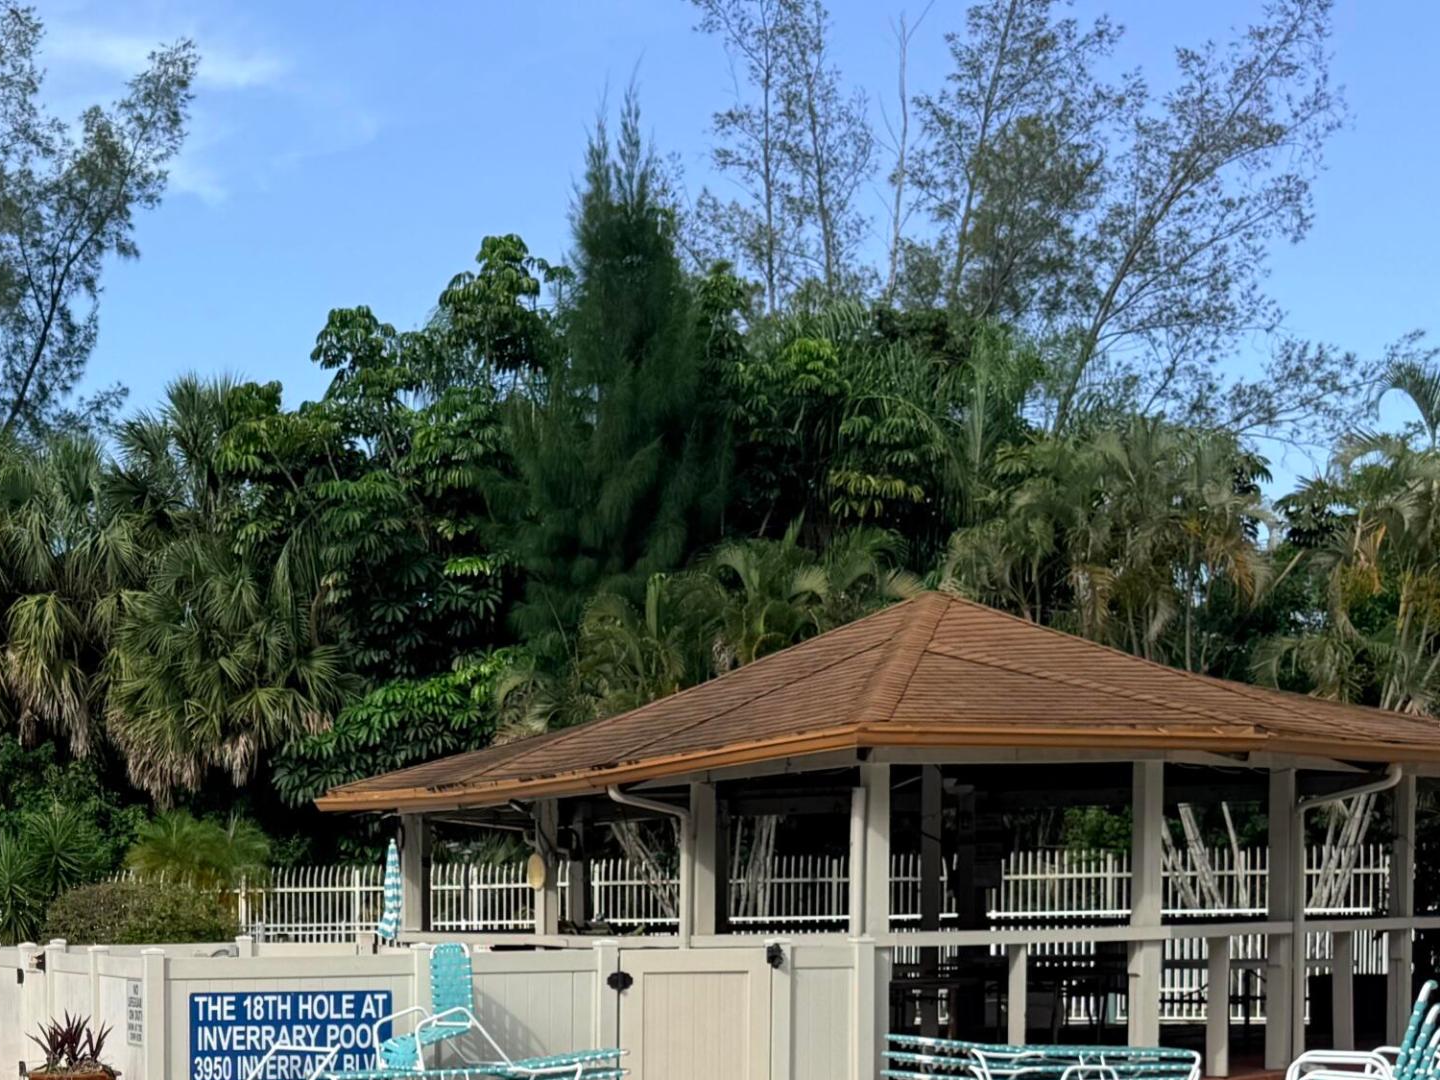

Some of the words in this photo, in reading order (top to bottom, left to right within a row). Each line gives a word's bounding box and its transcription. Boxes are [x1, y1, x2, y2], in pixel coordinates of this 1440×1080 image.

[194, 996, 236, 1021] THE
[243, 995, 291, 1020] 18TH
[299, 994, 355, 1019] HOLE
[361, 993, 388, 1019] AT
[198, 1024, 320, 1051] INVERRARY
